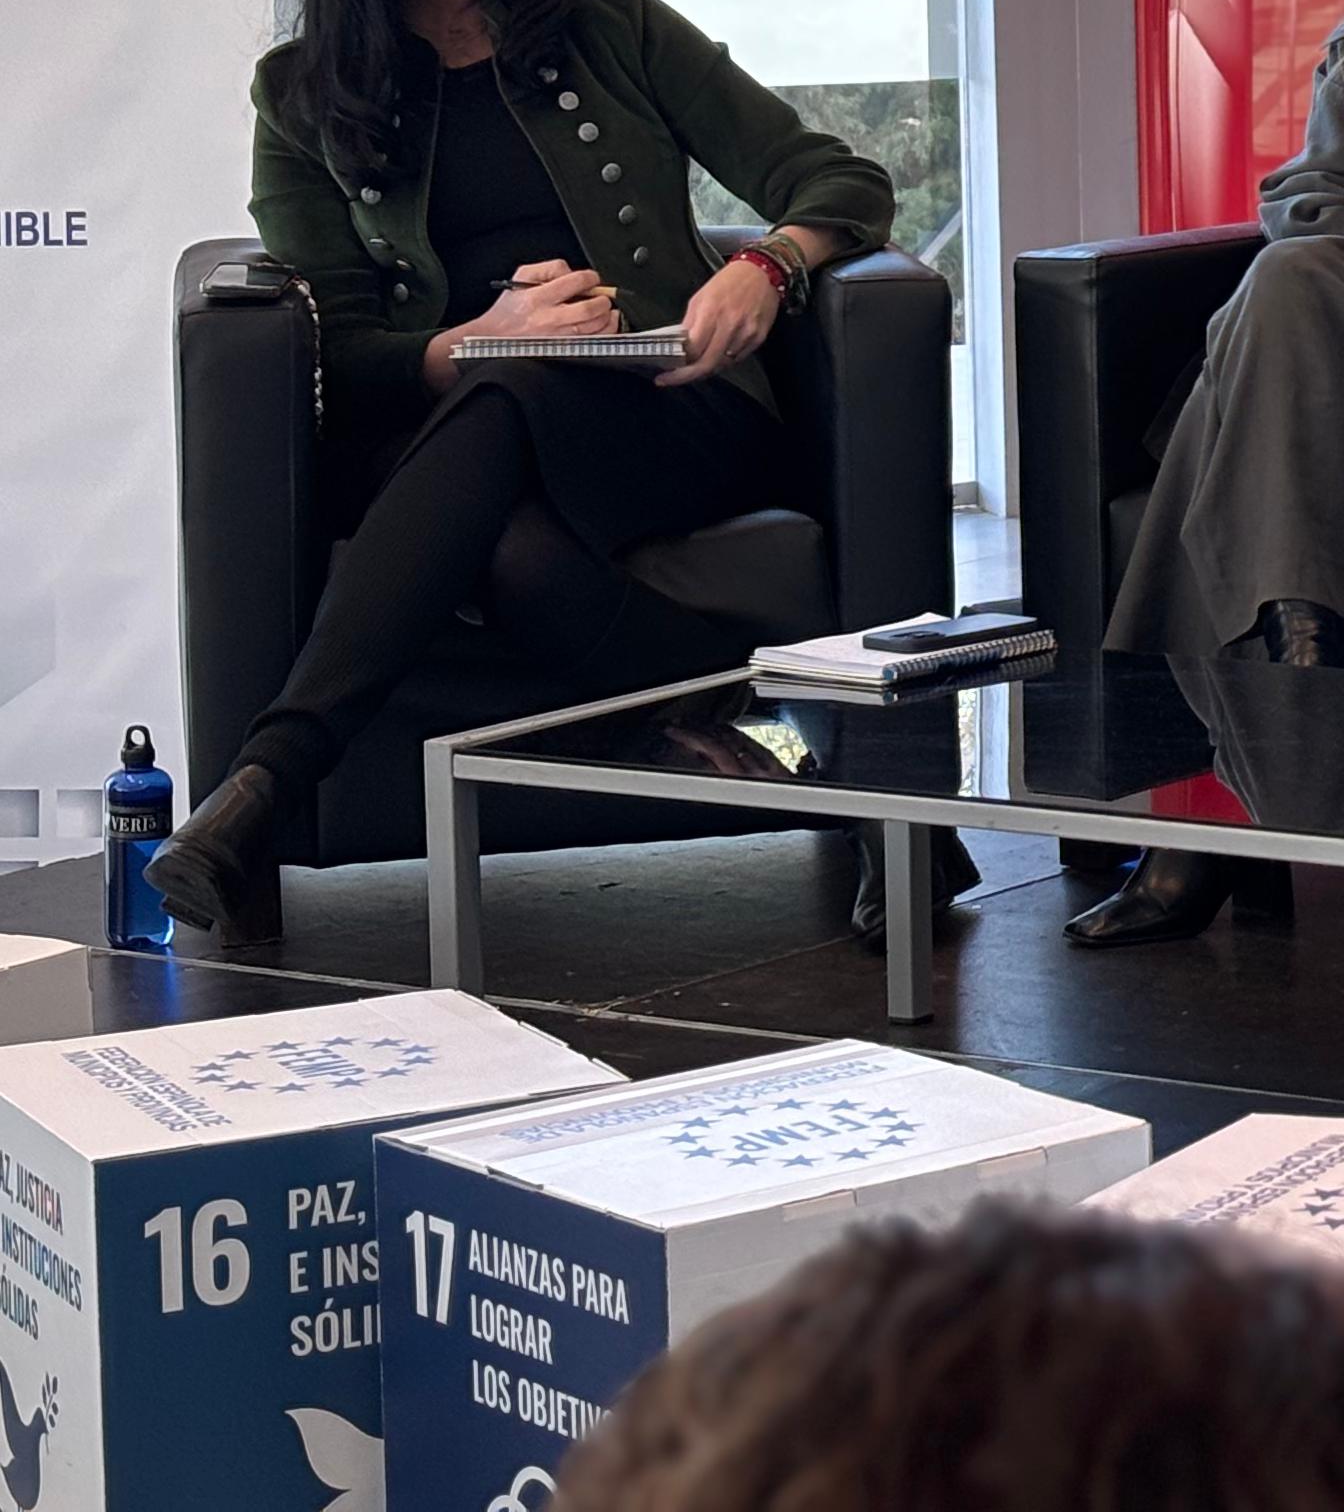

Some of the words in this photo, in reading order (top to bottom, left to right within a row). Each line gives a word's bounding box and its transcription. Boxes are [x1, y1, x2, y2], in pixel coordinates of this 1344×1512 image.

[0, 211, 88, 247] IBLE
[267, 1048, 367, 1079] FEMP
[730, 1113, 872, 1153] FEMP
[16, 1161, 64, 1236] JUSTICIA
[288, 1180, 366, 1230] PAZ,
[1, 1212, 82, 1313] INSTITUCIONES
[144, 1198, 251, 1314] 16
[289, 1251, 309, 1294] E
[405, 1209, 455, 1326] 17
[468, 1228, 566, 1302] ALIANZAS
[572, 1263, 630, 1325] PARA
[0, 1263, 39, 1341] ÓLIDAS
[290, 1297, 382, 1357] SÓLI
[470, 1293, 553, 1365] LOGRAR
[472, 1359, 512, 1414] LOS
[518, 1377, 612, 1440] OBJETIV
